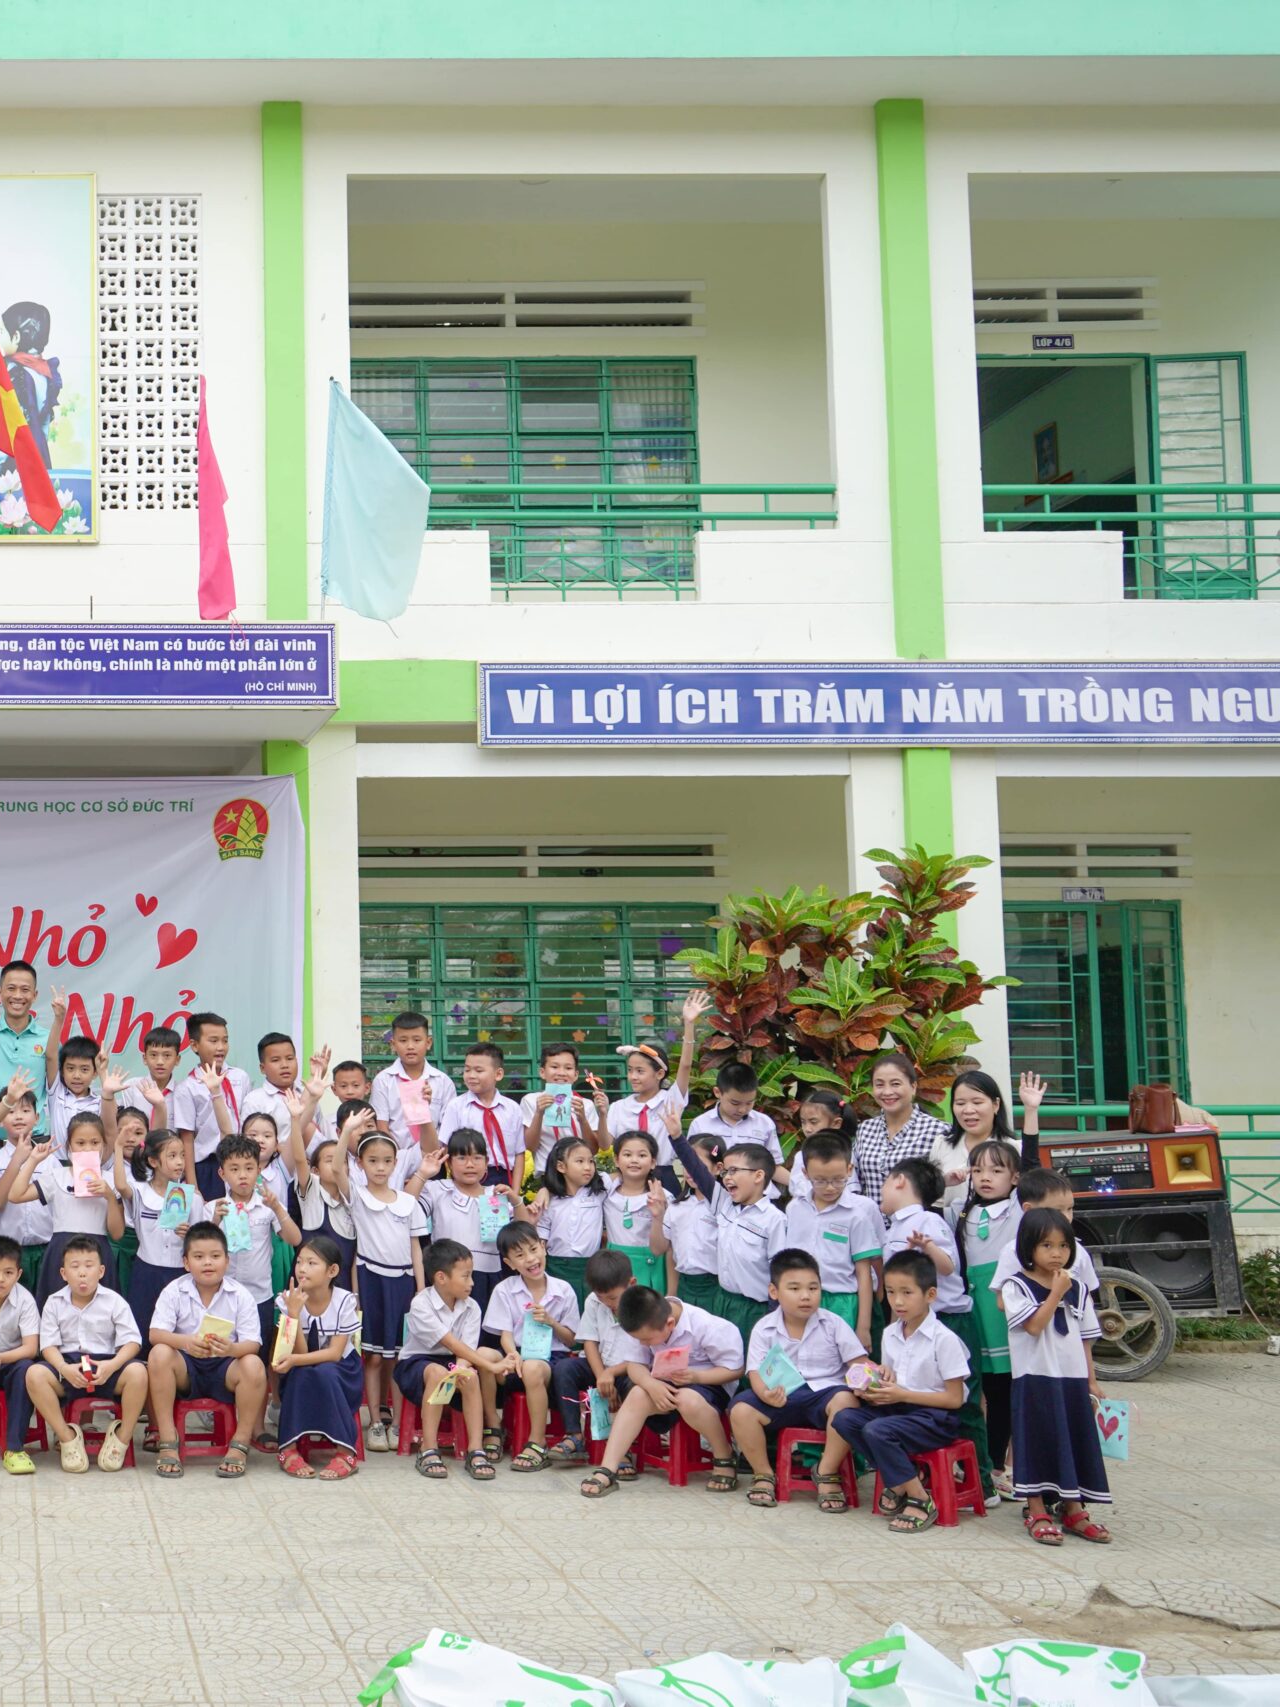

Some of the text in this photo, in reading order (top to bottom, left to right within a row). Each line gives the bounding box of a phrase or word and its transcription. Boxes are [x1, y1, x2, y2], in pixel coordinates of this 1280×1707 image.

[28, 637, 57, 651] dân
[61, 637, 86, 654] tộc
[89, 637, 120, 654] Việt
[123, 638, 160, 651] Nam
[164, 638, 183, 652] có
[187, 638, 226, 652] bước
[230, 637, 250, 652] tới
[255, 638, 279, 652] đài
[283, 638, 317, 652] vinh
[23, 657, 52, 672] hay
[54, 657, 107, 673] không,
[109, 657, 154, 671] chính
[156, 657, 172, 671] là
[174, 658, 204, 672] nhờ
[206, 658, 236, 674] một
[238, 655, 277, 673] phần
[280, 658, 305, 672] lớn
[307, 656, 318, 672] ở
[267, 680, 285, 692] CHÍ
[287, 682, 317, 694] MINH)
[507, 683, 555, 724] VÌ
[572, 683, 641, 731] LỢI
[659, 683, 738, 724] ÍCH
[754, 682, 884, 724] TRĂM
[902, 682, 1004, 723] NĂM
[1018, 676, 1174, 723] TRỒNG
[43, 801, 76, 814] HỌC
[80, 799, 103, 813] CƠ
[107, 797, 129, 813] SỞ
[132, 798, 165, 813] ĐỨC
[168, 798, 195, 813] TRÍ
[59, 989, 198, 1056] Nhỏ
